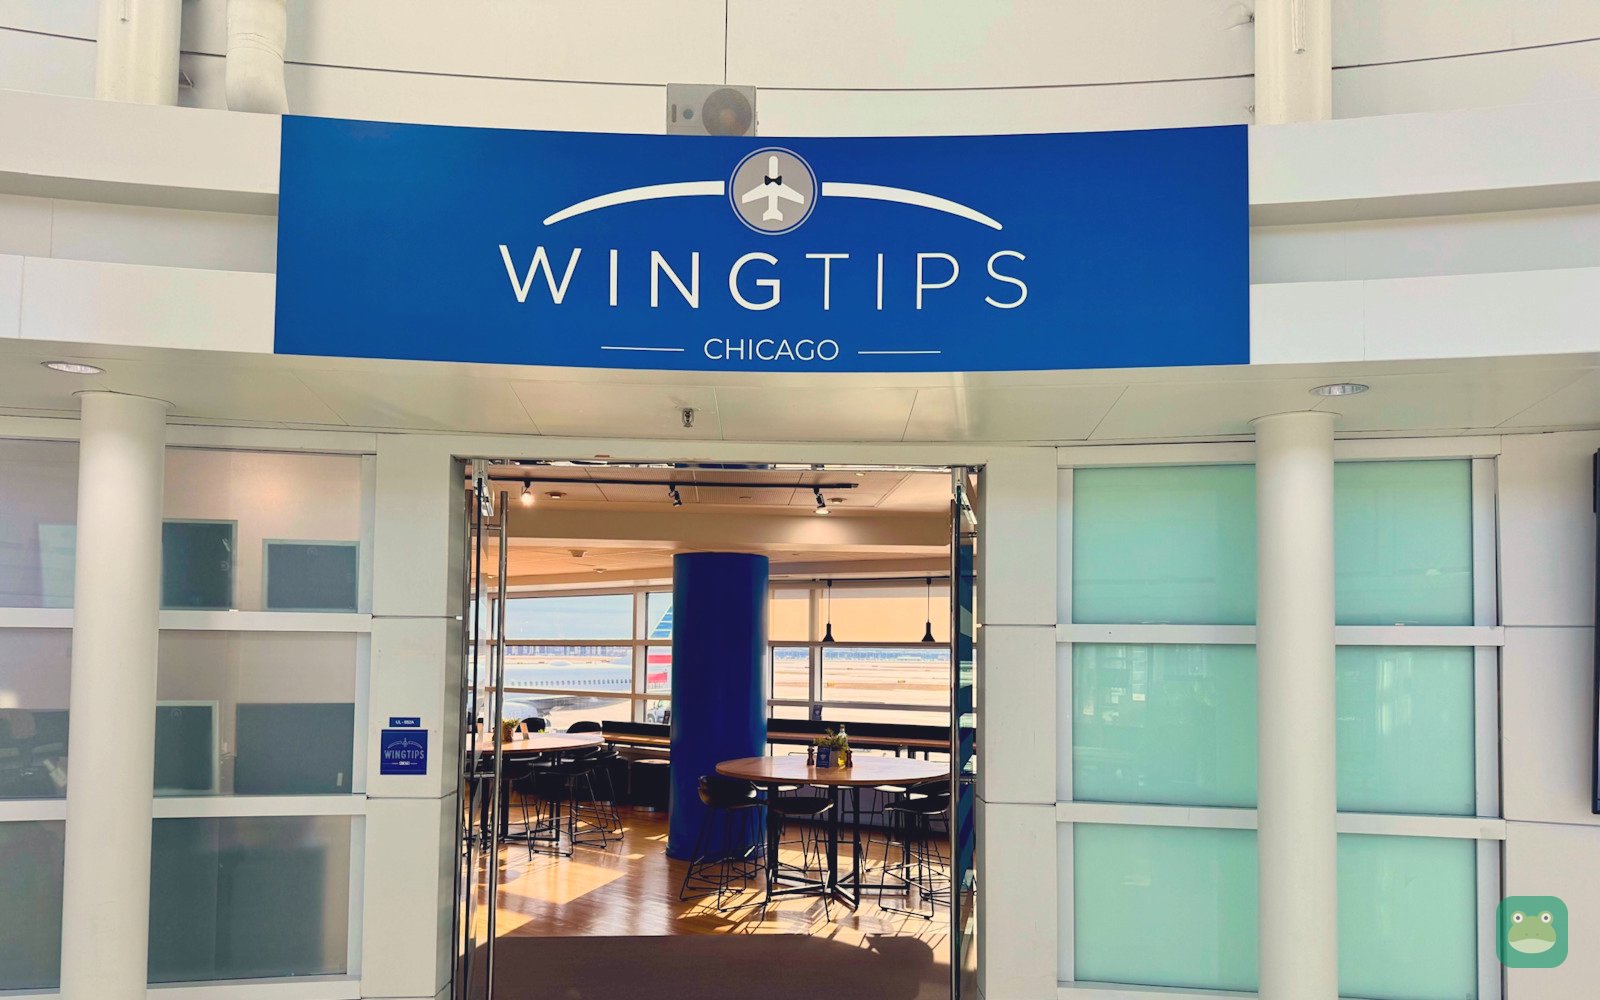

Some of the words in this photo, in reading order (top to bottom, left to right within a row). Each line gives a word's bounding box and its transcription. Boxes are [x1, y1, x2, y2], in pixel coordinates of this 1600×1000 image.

[498, 244, 1029, 312] WINGTIPS
[703, 338, 840, 362] CHICAGO
[384, 750, 424, 759] WINGTIPS
